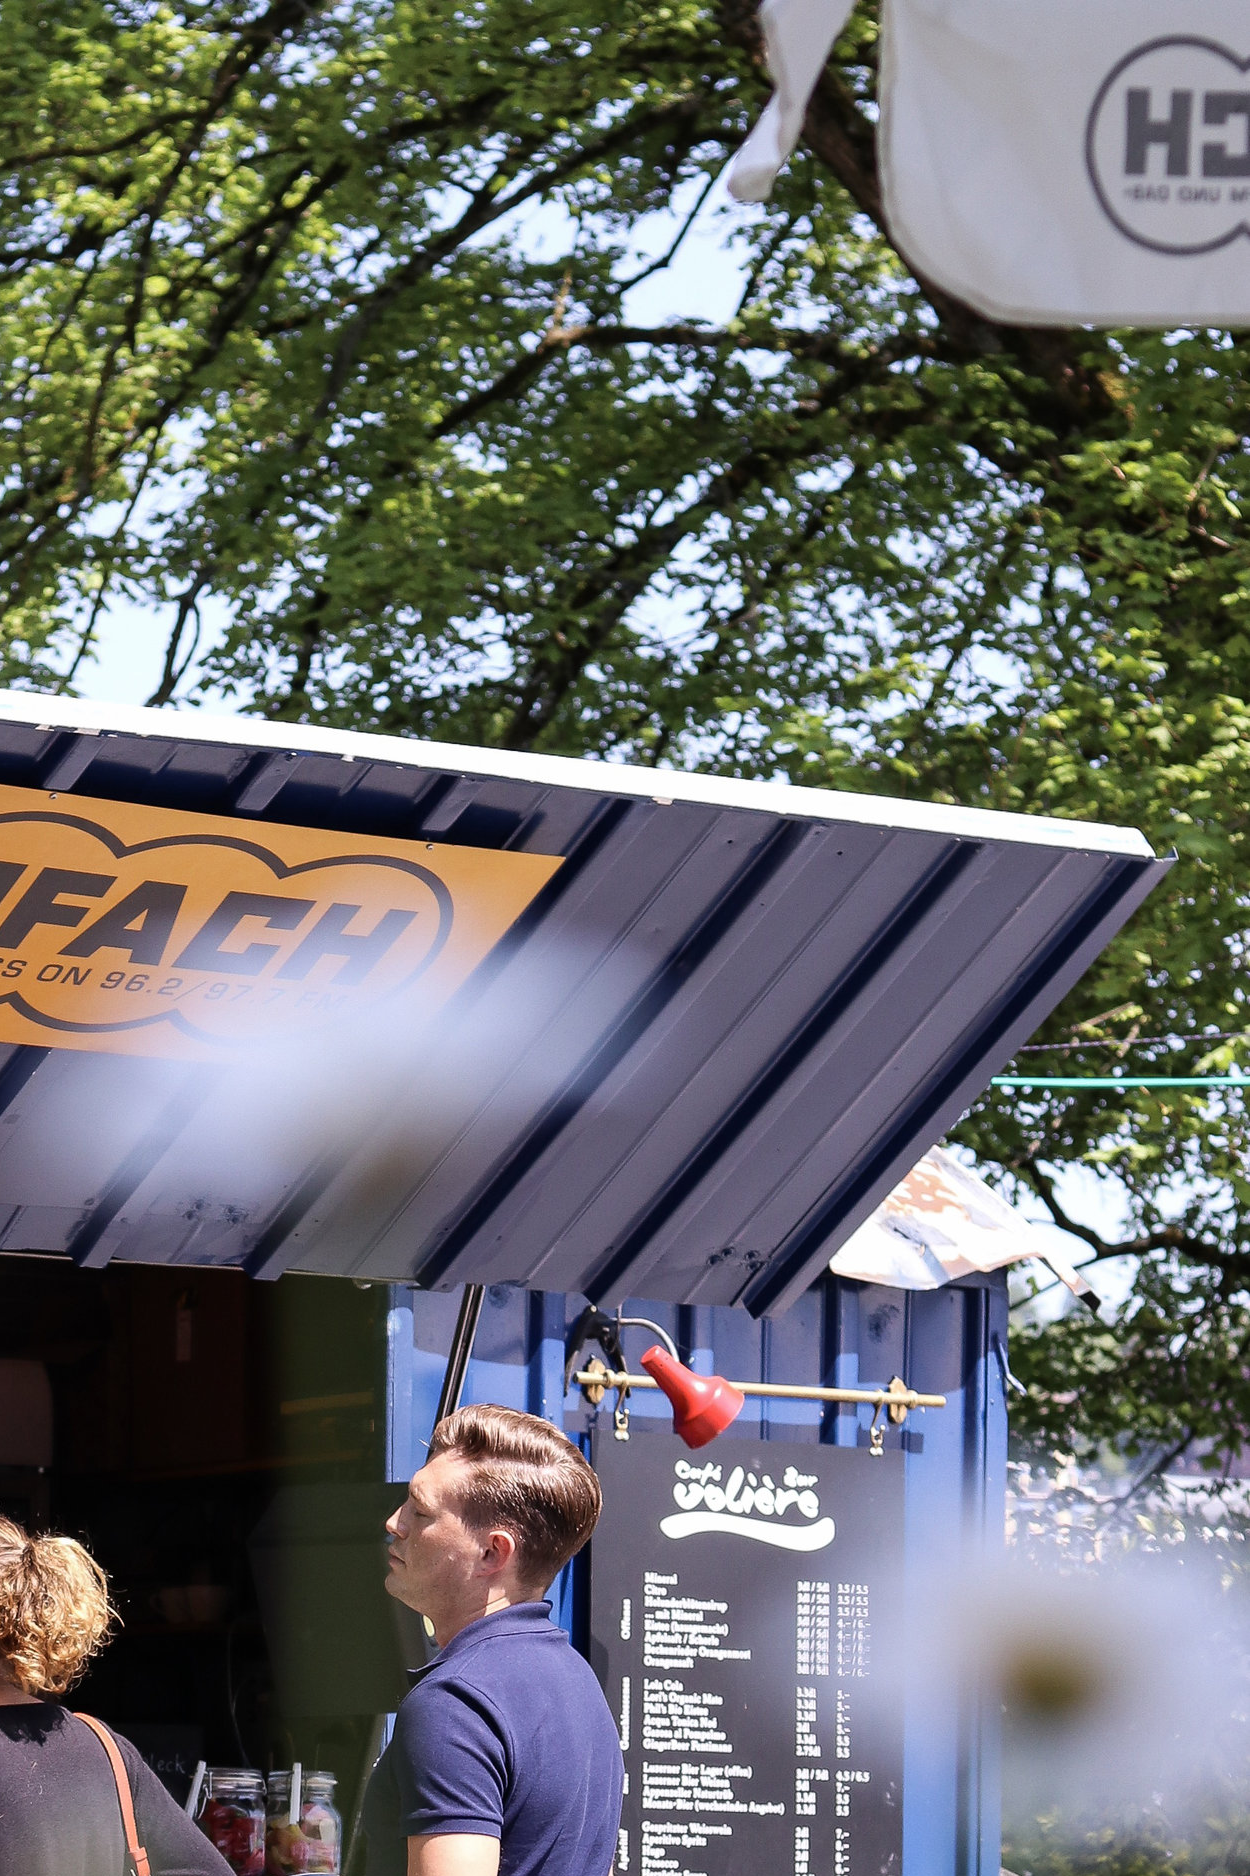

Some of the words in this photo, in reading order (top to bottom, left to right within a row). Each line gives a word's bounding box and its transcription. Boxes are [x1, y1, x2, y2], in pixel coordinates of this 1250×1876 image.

[36, 963, 92, 986] ON
[99, 970, 286, 1010] 96.2/97.7
[645, 1572, 677, 1584] Mineral
[645, 1584, 666, 1595] Citro
[672, 1610, 703, 1621] Mineral
[645, 1620, 669, 1631] Eistee
[664, 1680, 683, 1691] Cola
[682, 1764, 699, 1774] Bier
[701, 1765, 723, 1777] Lager
[725, 1766, 752, 1778] (offen)
[682, 1776, 699, 1786] Bier
[682, 1835, 707, 1847] Spritz
[642, 1845, 665, 1858] Hugo
[642, 1857, 678, 1868] Prosecco
